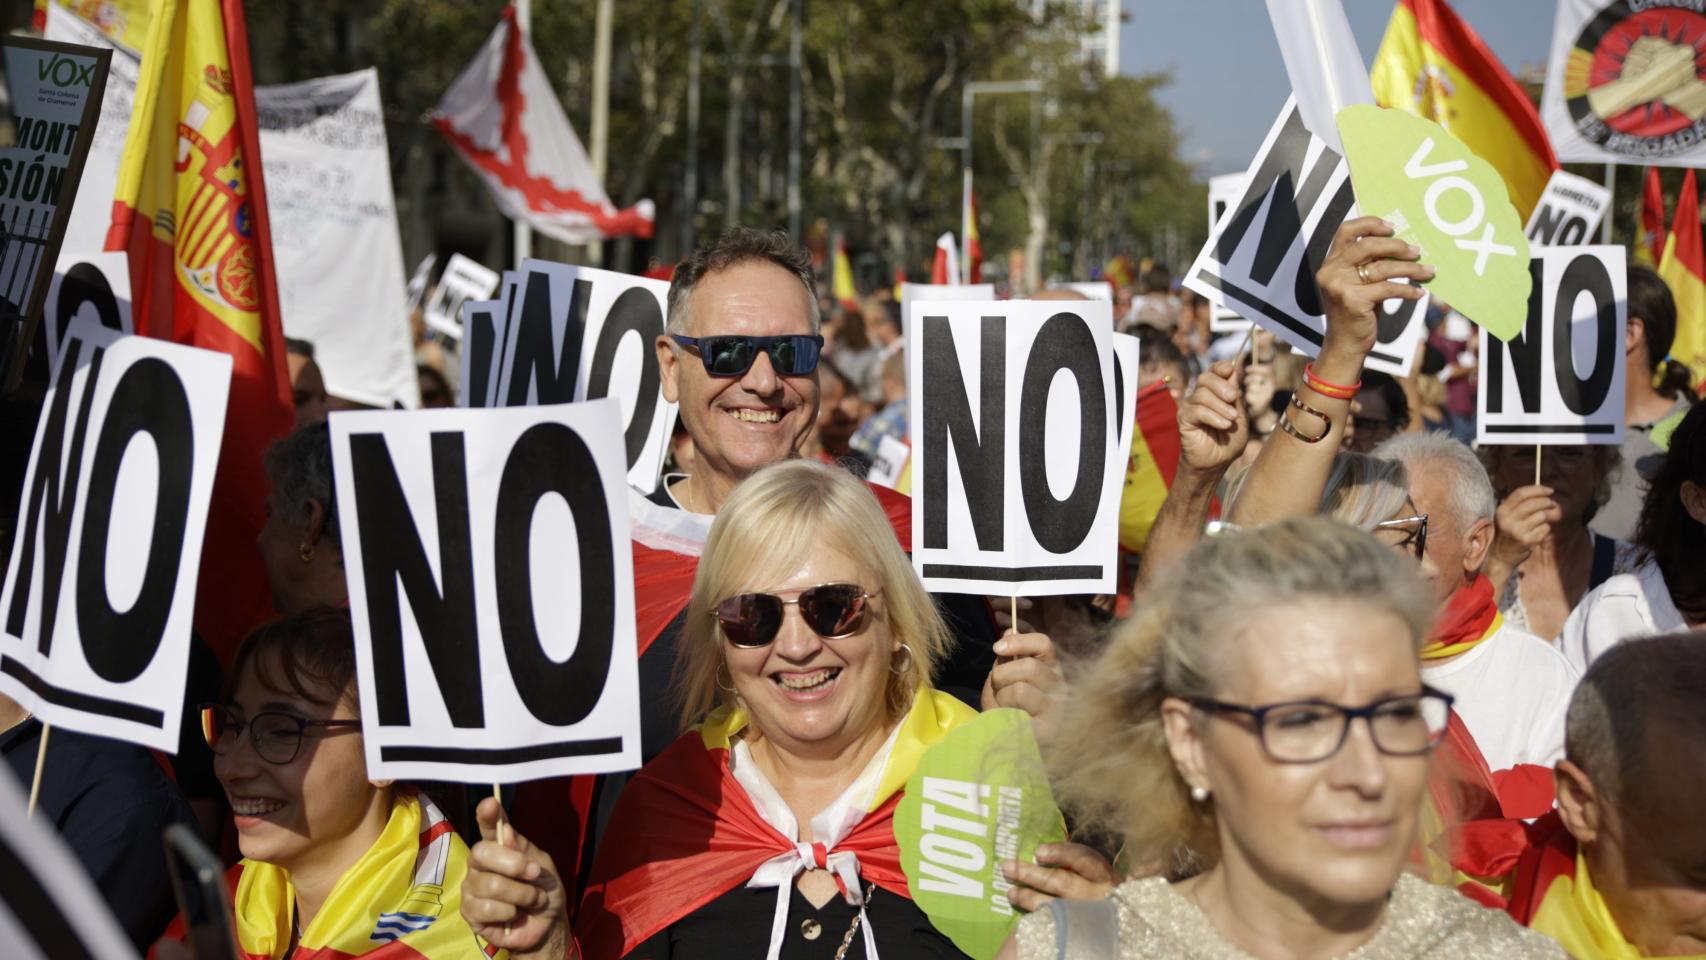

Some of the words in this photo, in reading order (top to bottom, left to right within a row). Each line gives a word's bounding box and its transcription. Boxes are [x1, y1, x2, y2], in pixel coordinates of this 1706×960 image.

[38, 54, 96, 87] VOX
[1404, 136, 1518, 278] VOX
[1528, 203, 1588, 246] NO
[506, 270, 665, 472] NO
[1486, 254, 1617, 416] NO
[922, 312, 1107, 554] NO
[5, 337, 194, 684] NO
[349, 421, 616, 728] NO
[918, 776, 991, 899] VOTA
[994, 786, 1022, 860] IMPORTA
